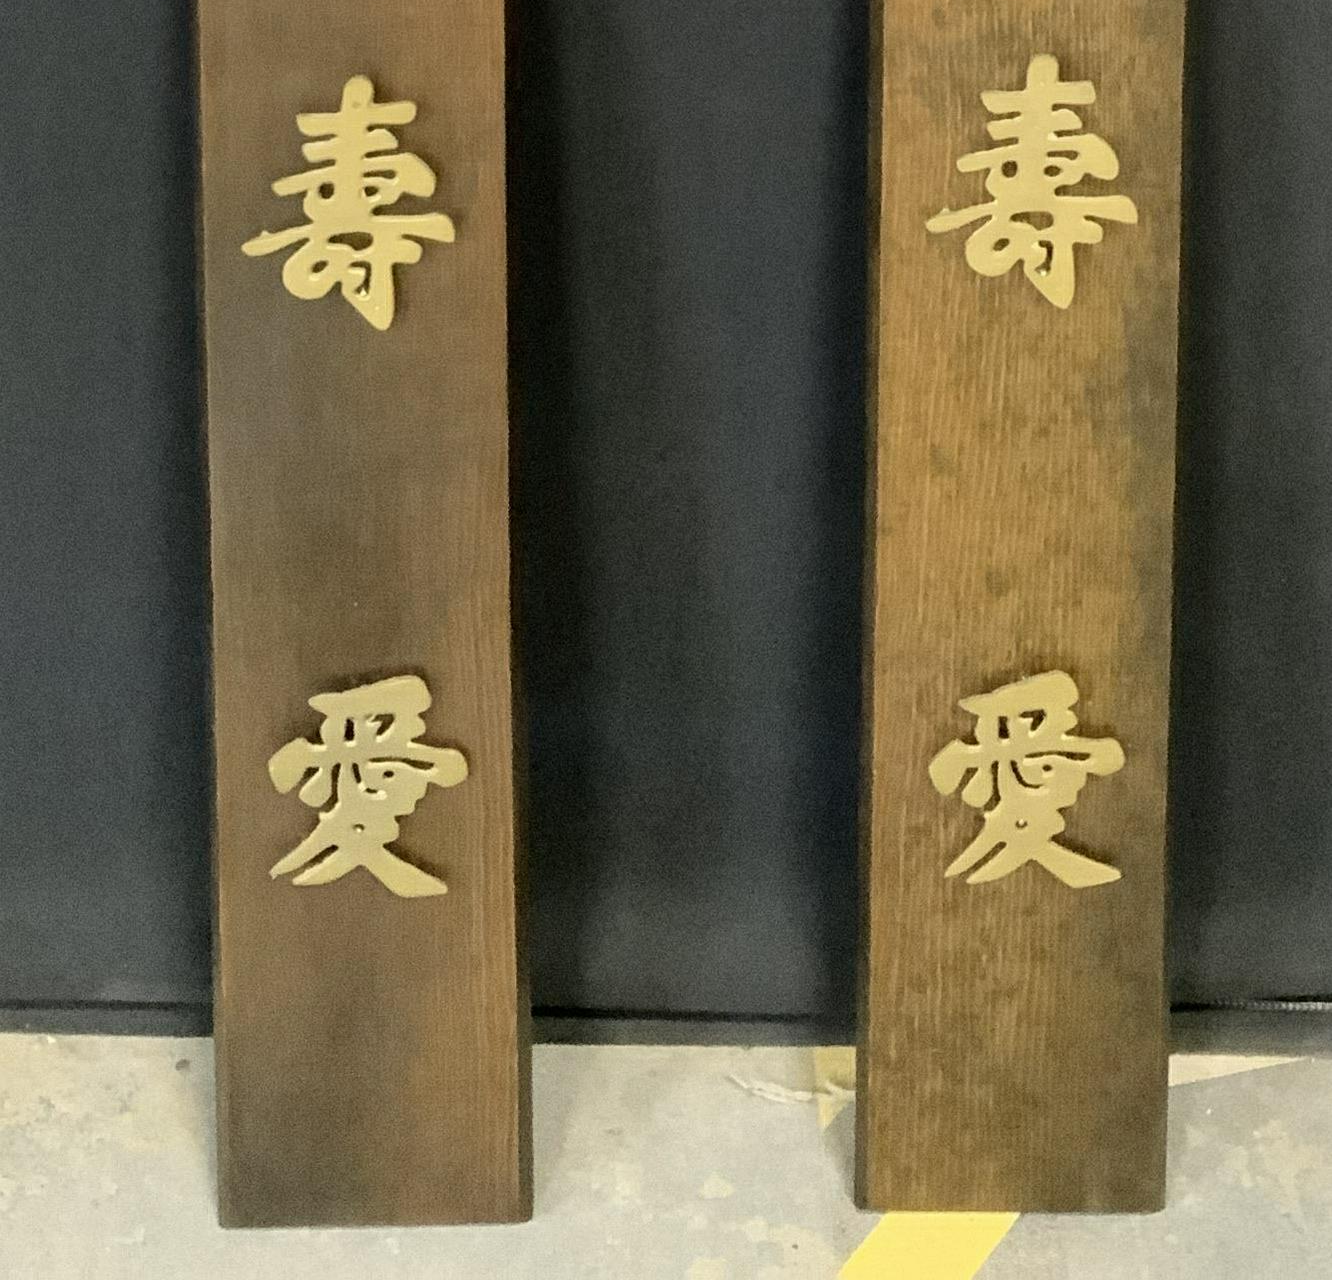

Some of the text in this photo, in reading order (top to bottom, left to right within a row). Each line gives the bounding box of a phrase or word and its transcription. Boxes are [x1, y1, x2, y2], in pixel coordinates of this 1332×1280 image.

[241, 74, 457, 332] 壽
[926, 53, 1139, 310] 壽
[267, 674, 469, 899] 愛
[928, 669, 1126, 889] 愛
